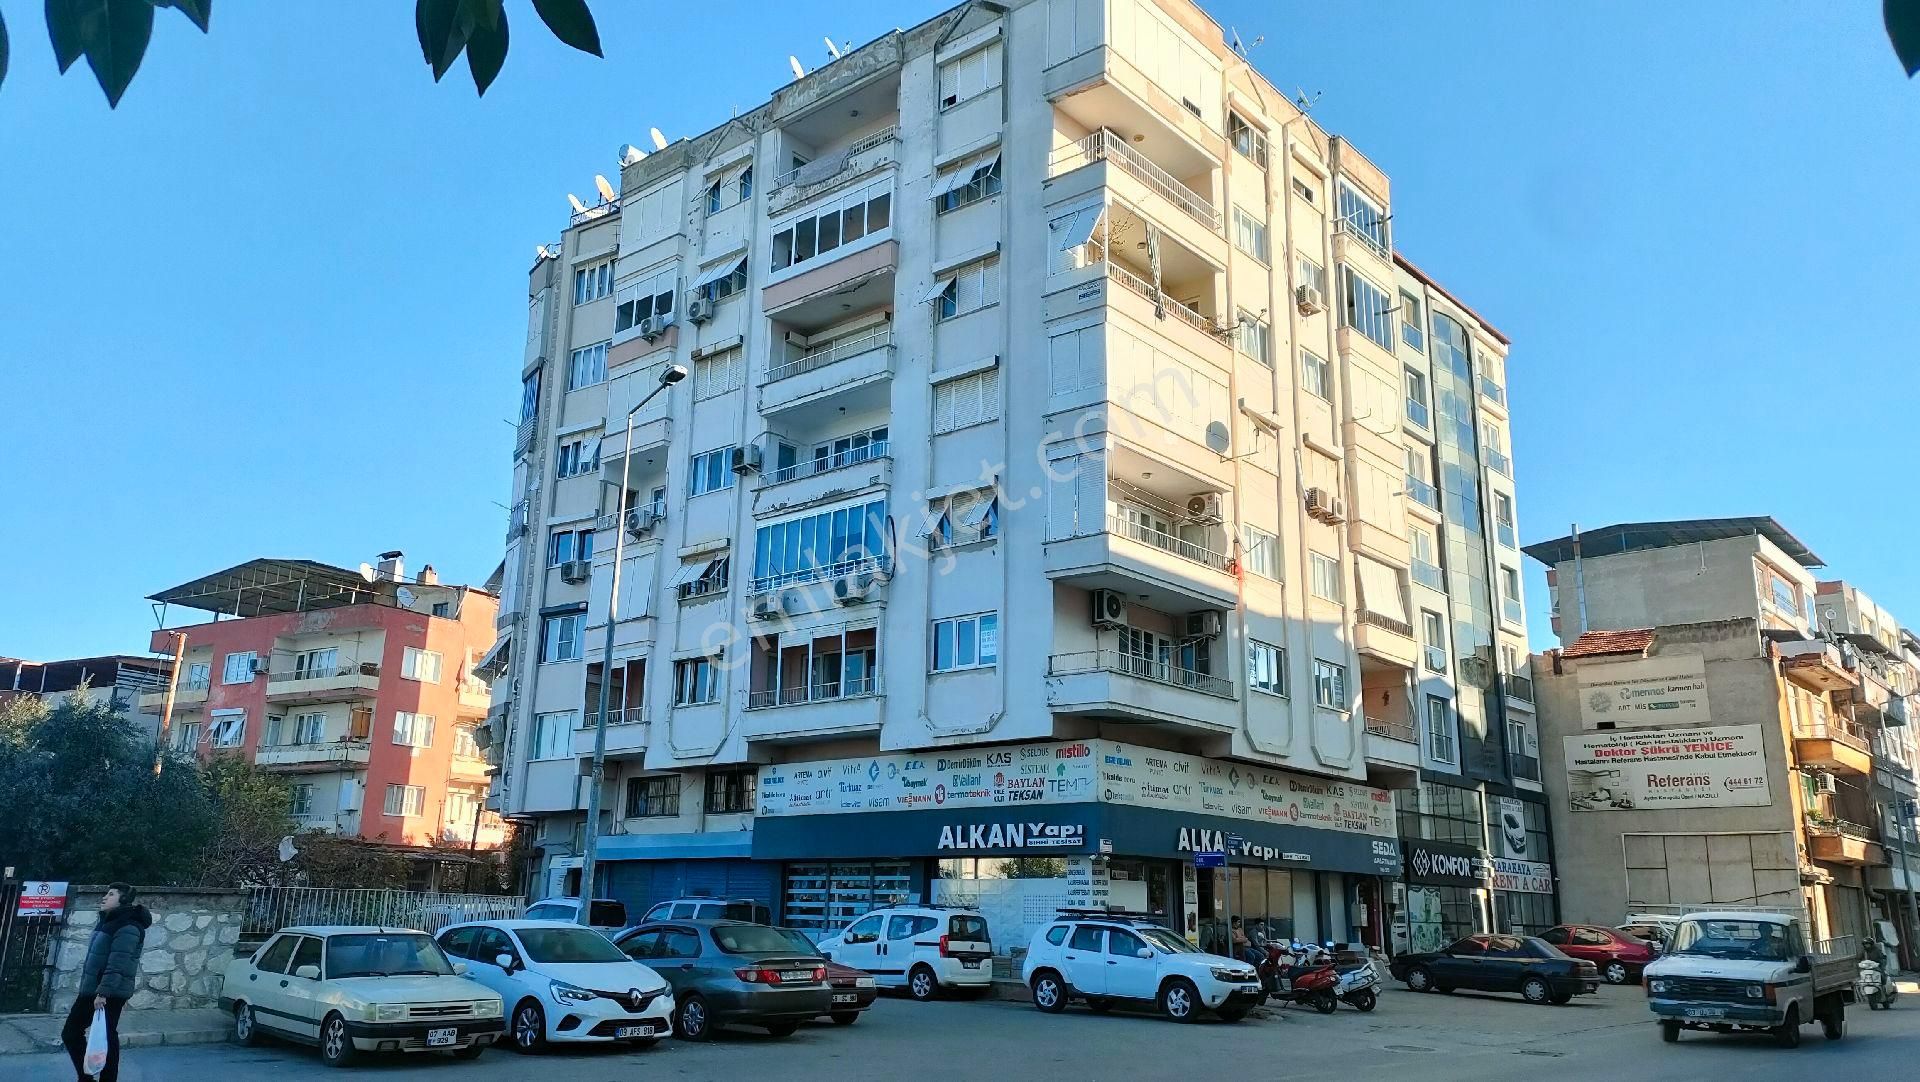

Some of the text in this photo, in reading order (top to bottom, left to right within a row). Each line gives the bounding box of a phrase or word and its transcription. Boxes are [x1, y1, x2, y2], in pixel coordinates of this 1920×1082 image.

[987, 753, 1012, 765] KAS
[1594, 748, 1637, 758] Doktor
[1007, 777, 1045, 789] BAYLAN
[1647, 774, 1711, 787] Referans
[1008, 790, 1044, 801] TEKSAN
[1327, 785, 1345, 796] KAS
[937, 823, 1024, 849] ALKAN
[1372, 841, 1396, 856] SEDA
[1431, 853, 1471, 877] KONFOR
[1493, 874, 1520, 889] RENT
[1523, 877, 1529, 890] A
[1532, 877, 1551, 892] CAR
